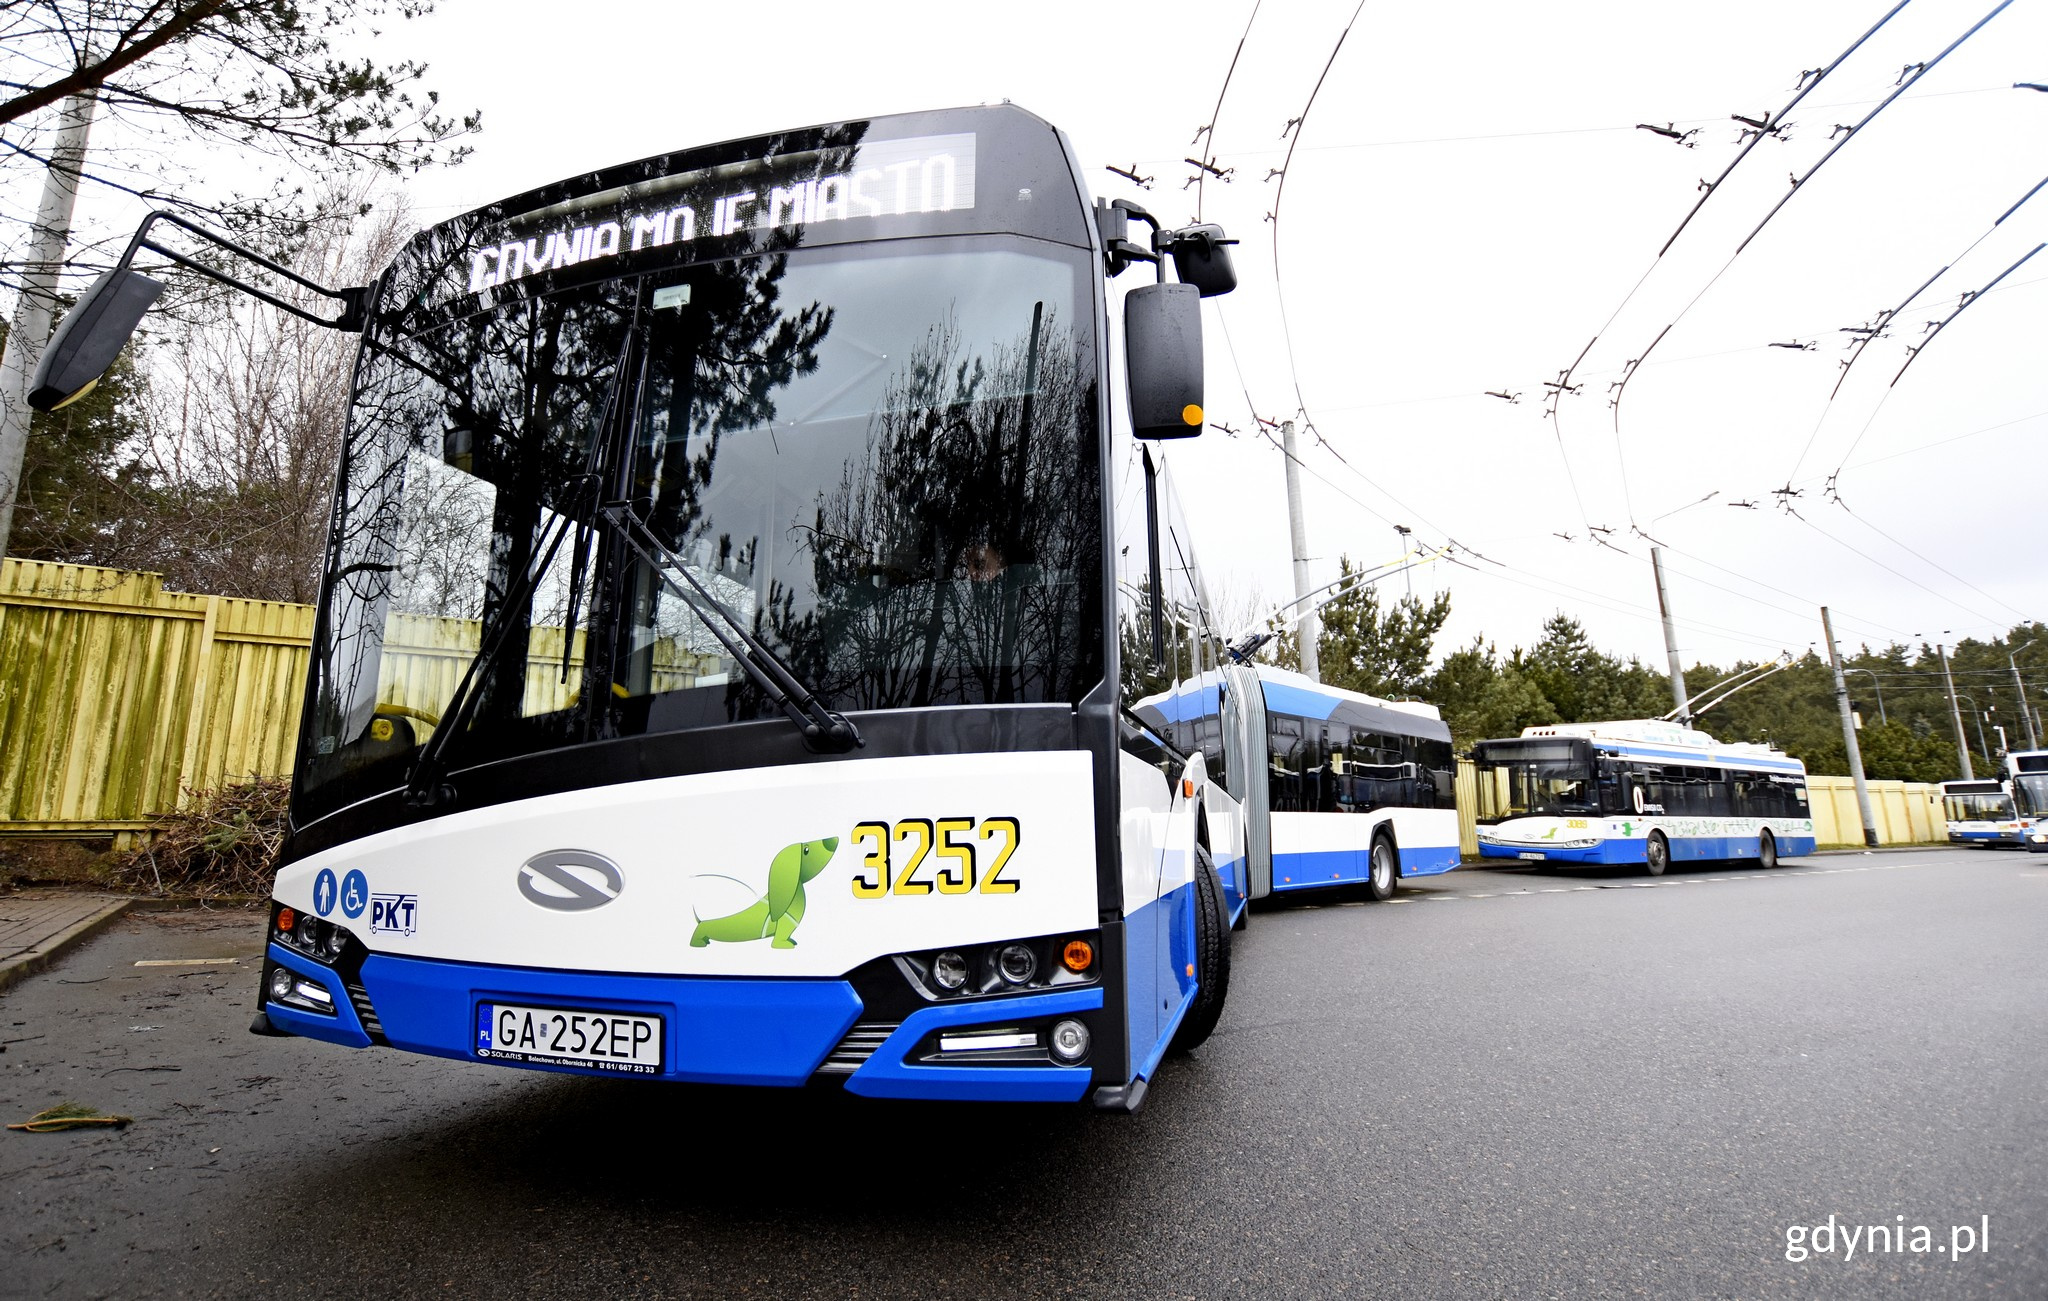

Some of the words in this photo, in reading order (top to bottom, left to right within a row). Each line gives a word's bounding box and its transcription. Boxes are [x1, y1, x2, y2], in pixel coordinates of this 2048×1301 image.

[850, 816, 1021, 899] 3252
[371, 895, 415, 929] PKT
[480, 1030, 491, 1041] PL
[499, 1009, 537, 1049] GA
[550, 1014, 652, 1059] 252EP
[491, 1050, 523, 1061] SOLARIS
[633, 1065, 644, 1073] 23
[645, 1066, 655, 1074] 33
